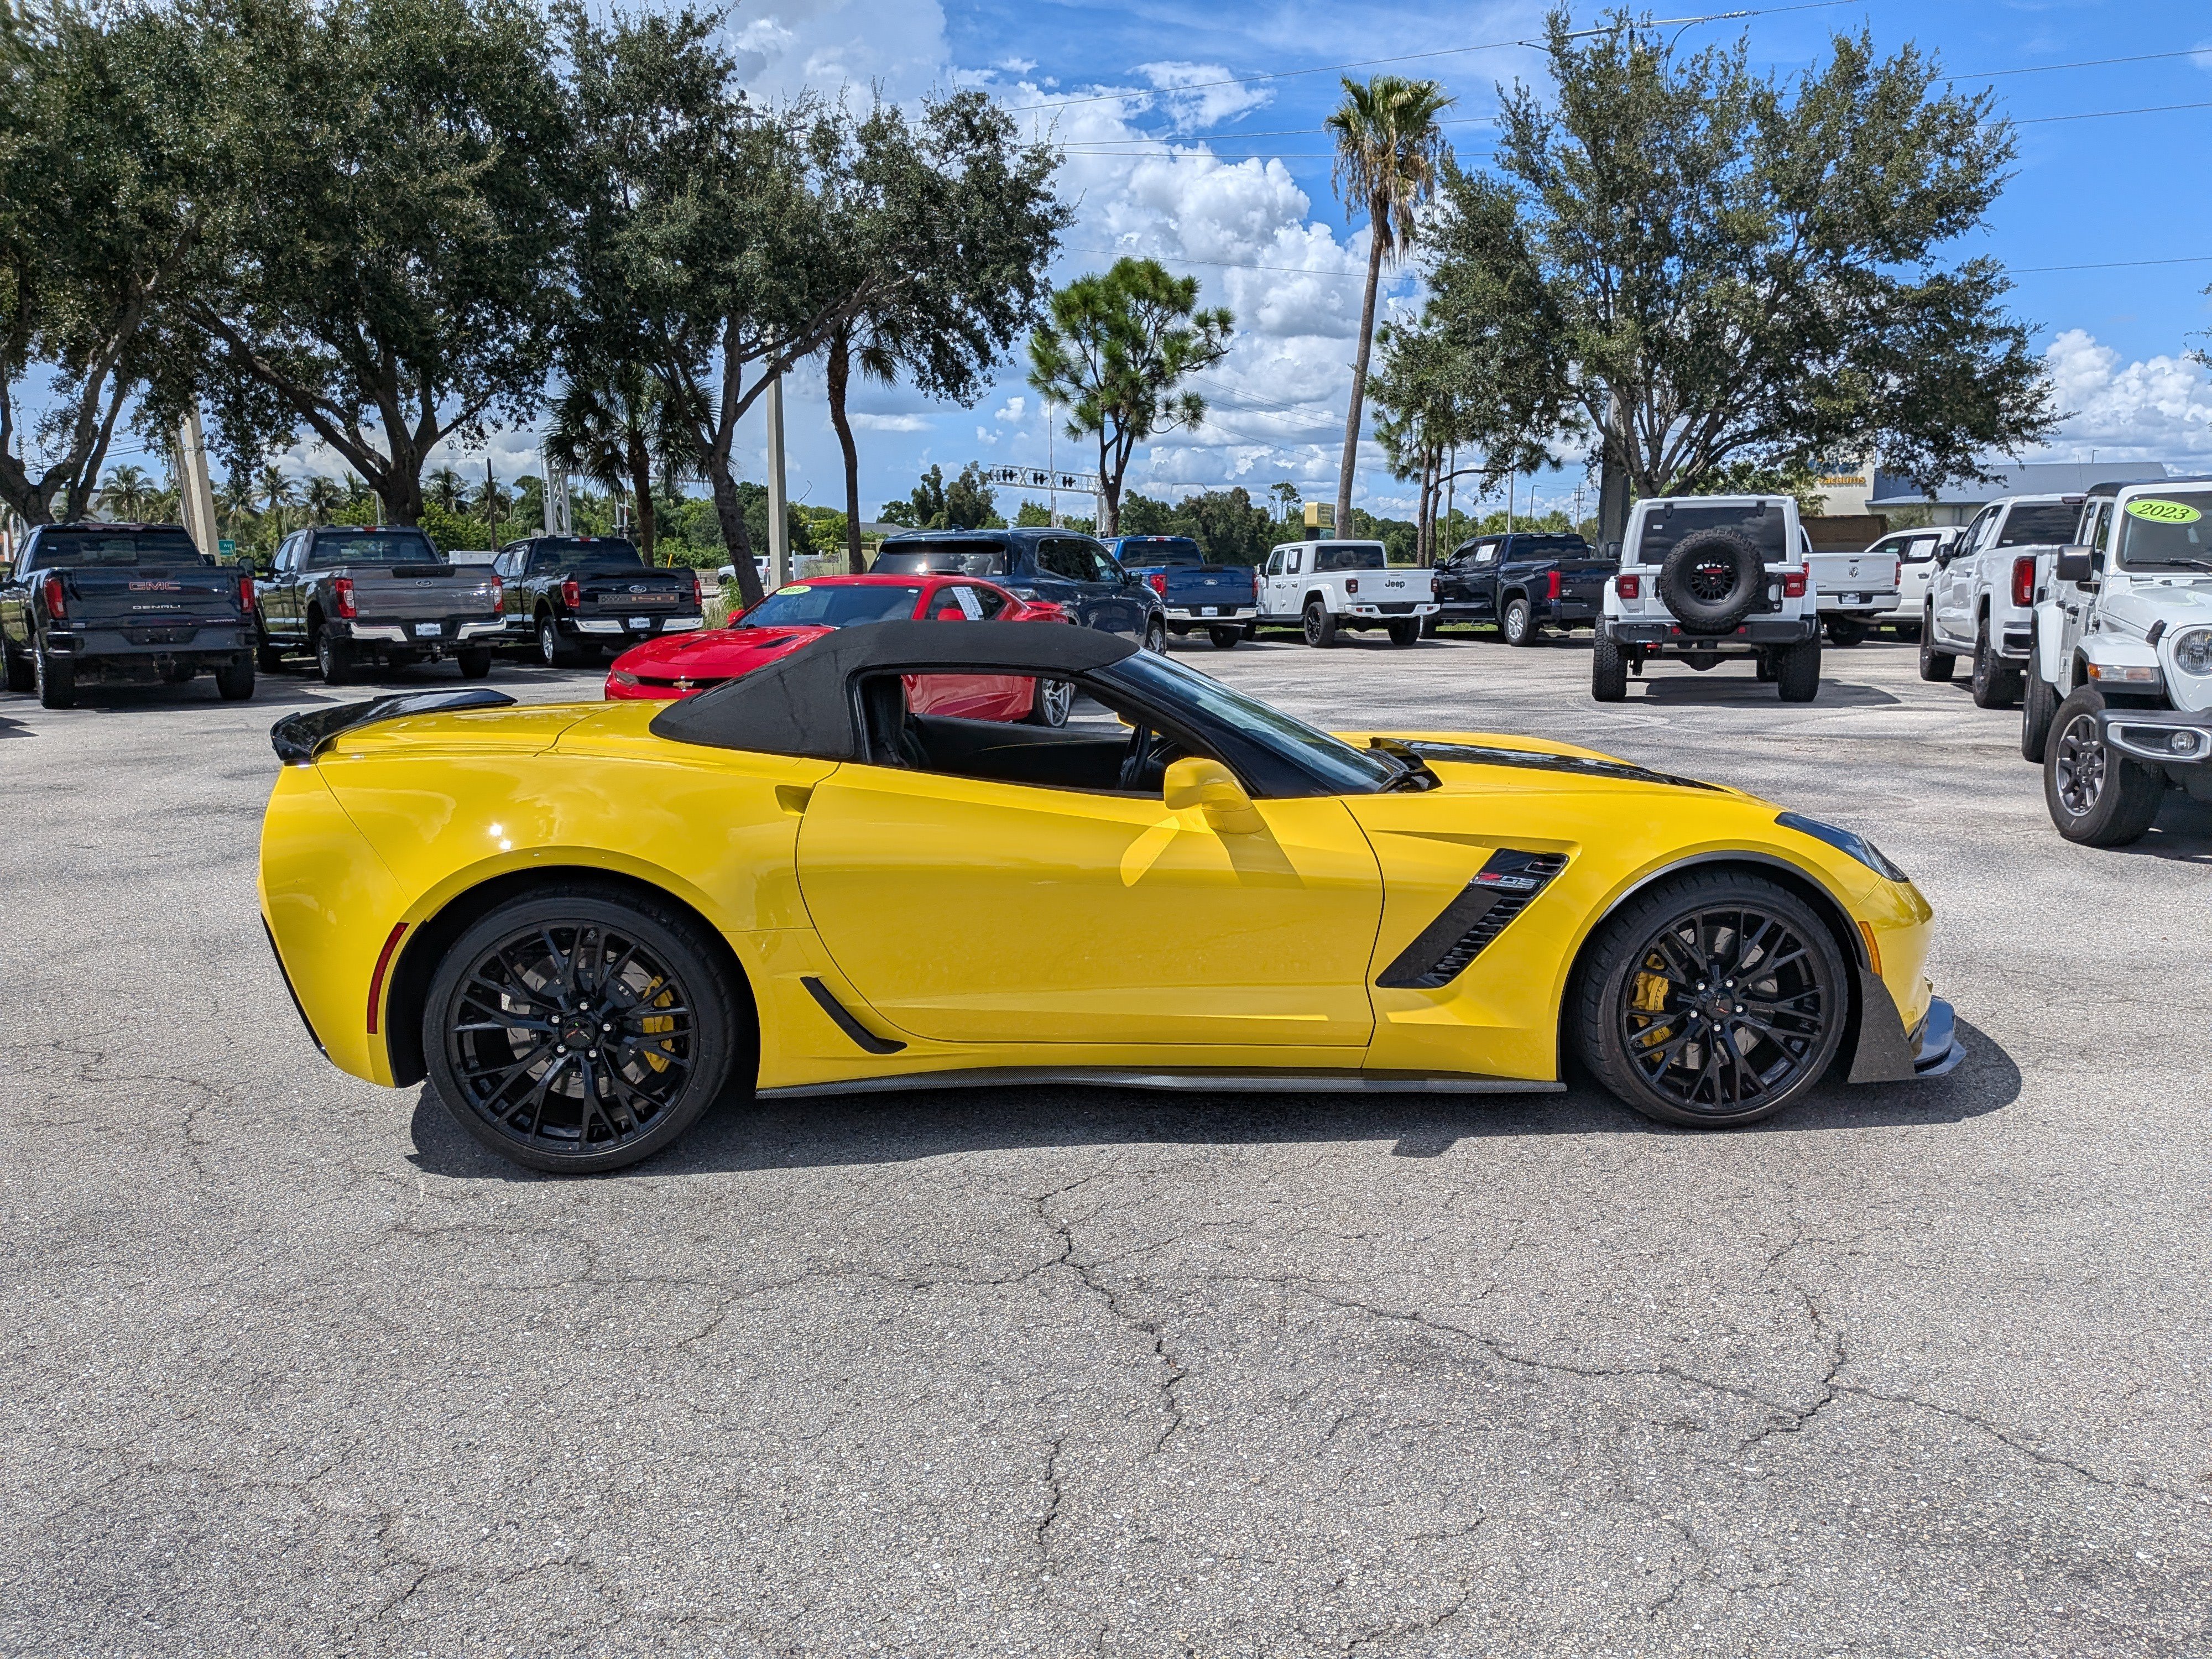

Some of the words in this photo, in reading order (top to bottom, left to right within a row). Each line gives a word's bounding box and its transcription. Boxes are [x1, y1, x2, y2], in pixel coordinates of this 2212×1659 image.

[2137, 503, 2190, 519] 2023
[129, 581, 181, 591] GMC
[1385, 579, 1405, 589] Jeep
[1479, 872, 1537, 886] Z06
